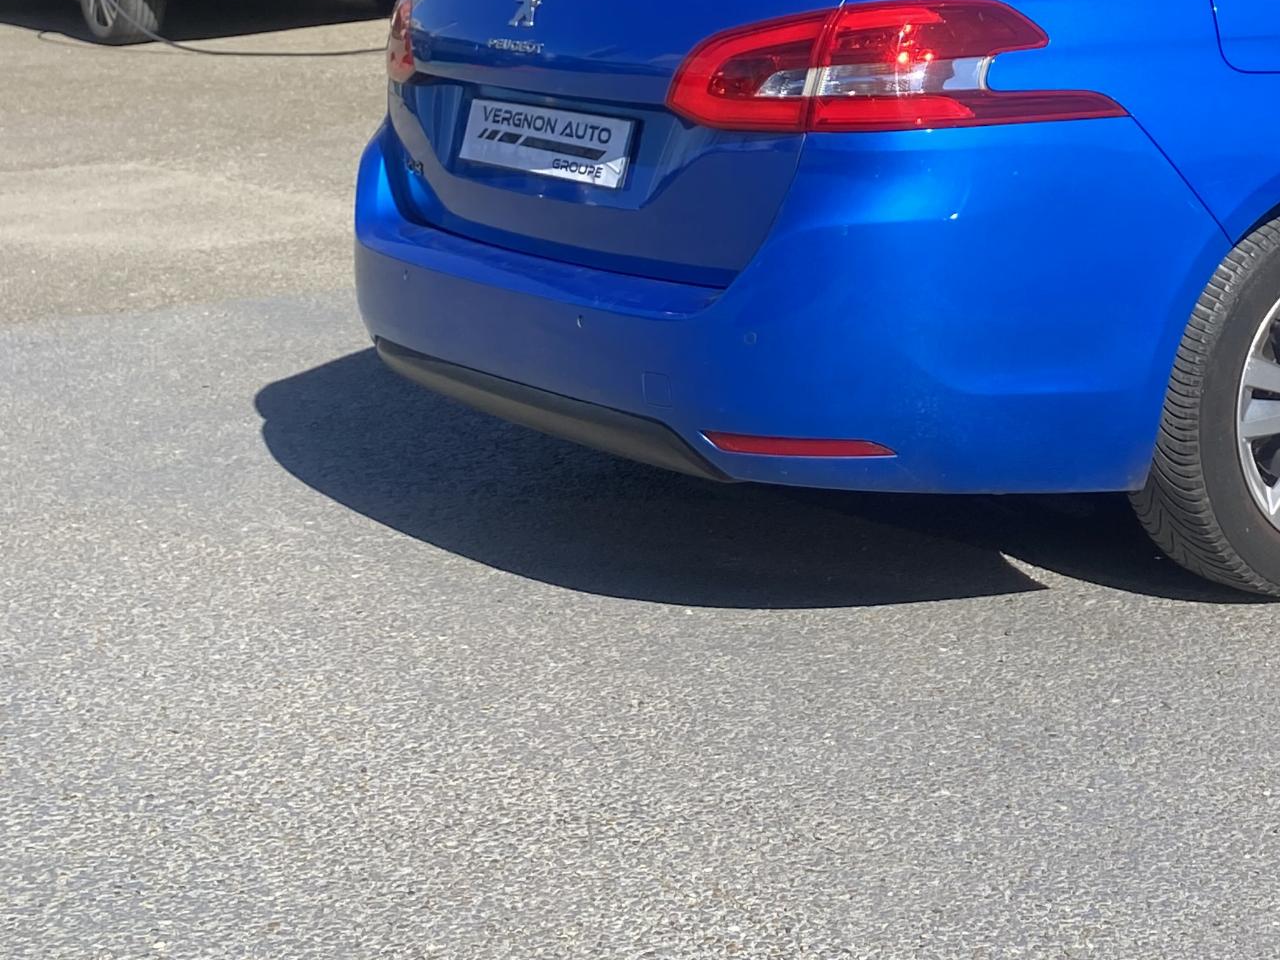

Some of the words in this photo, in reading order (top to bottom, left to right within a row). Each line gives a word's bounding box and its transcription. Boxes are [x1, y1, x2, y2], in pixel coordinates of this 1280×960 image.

[487, 38, 545, 54] PEUGEOT
[481, 105, 558, 135] VERGNON
[559, 119, 613, 145] AUTO
[552, 158, 603, 179] GROUPE
